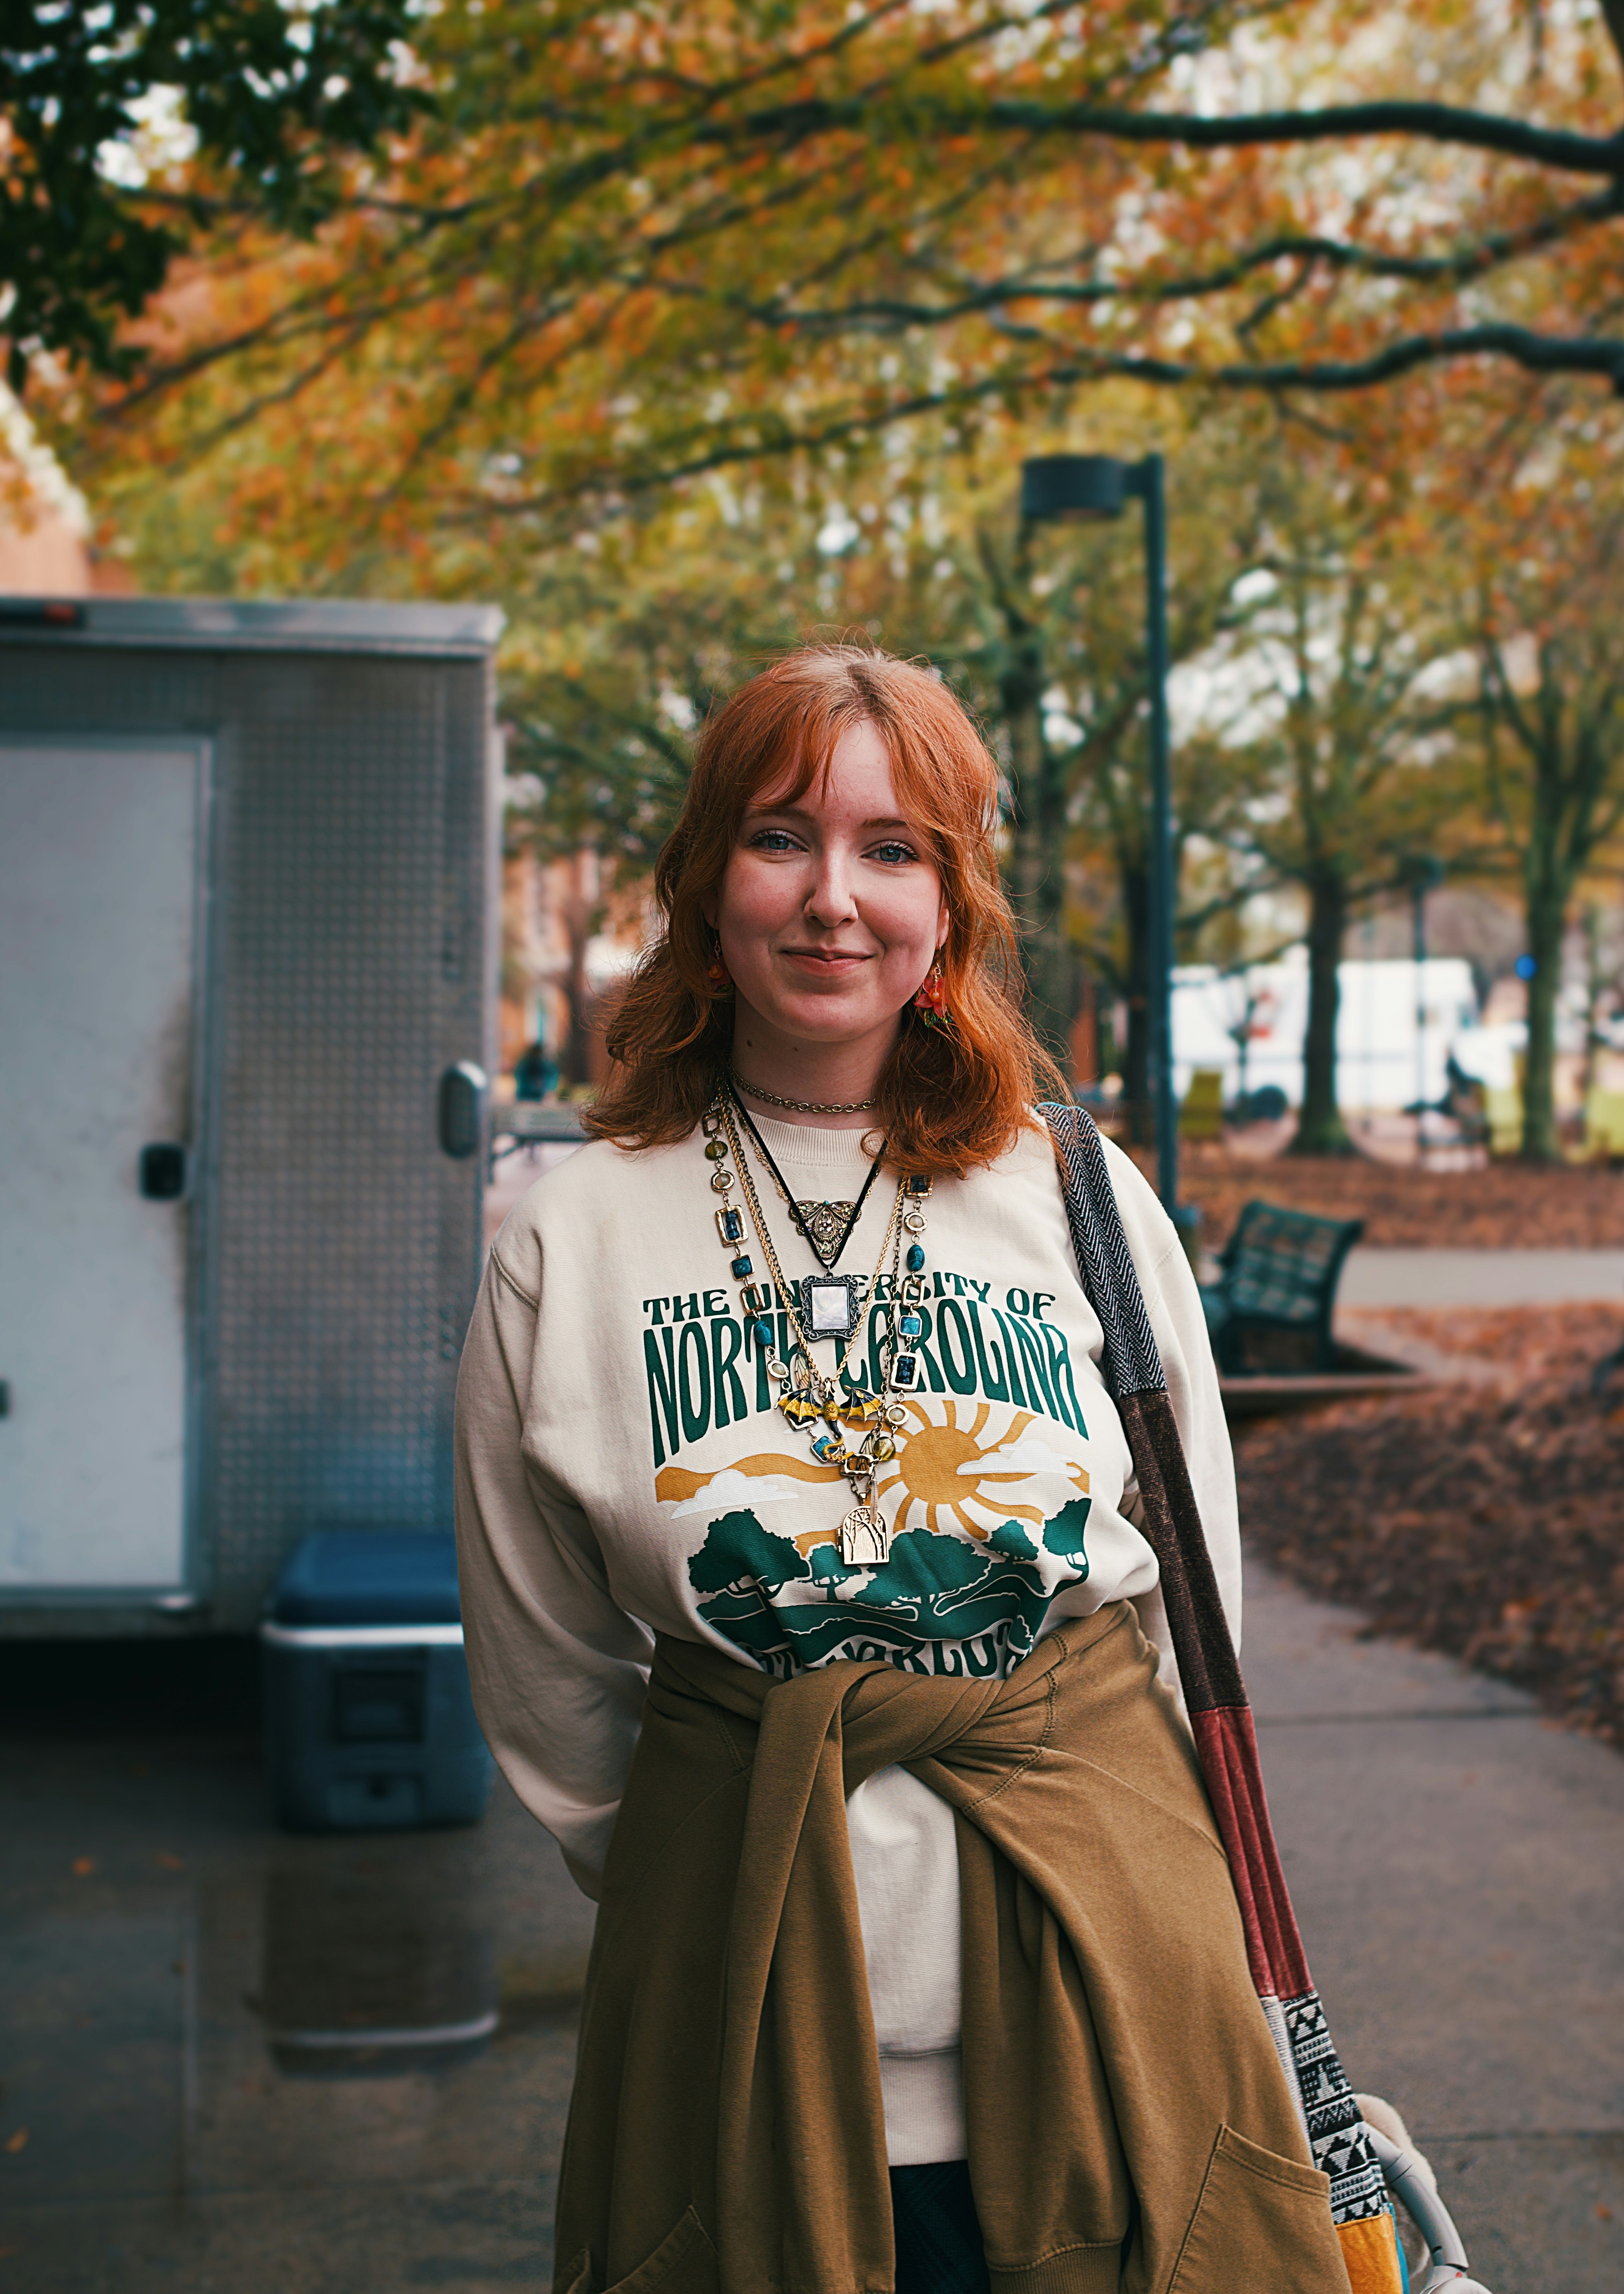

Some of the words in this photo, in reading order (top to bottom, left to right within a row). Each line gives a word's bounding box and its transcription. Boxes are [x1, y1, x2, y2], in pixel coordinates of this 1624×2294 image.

[643, 1289, 730, 1325] THE
[746, 1272, 991, 1312] UNERSITY
[1007, 1288, 1056, 1320] OF
